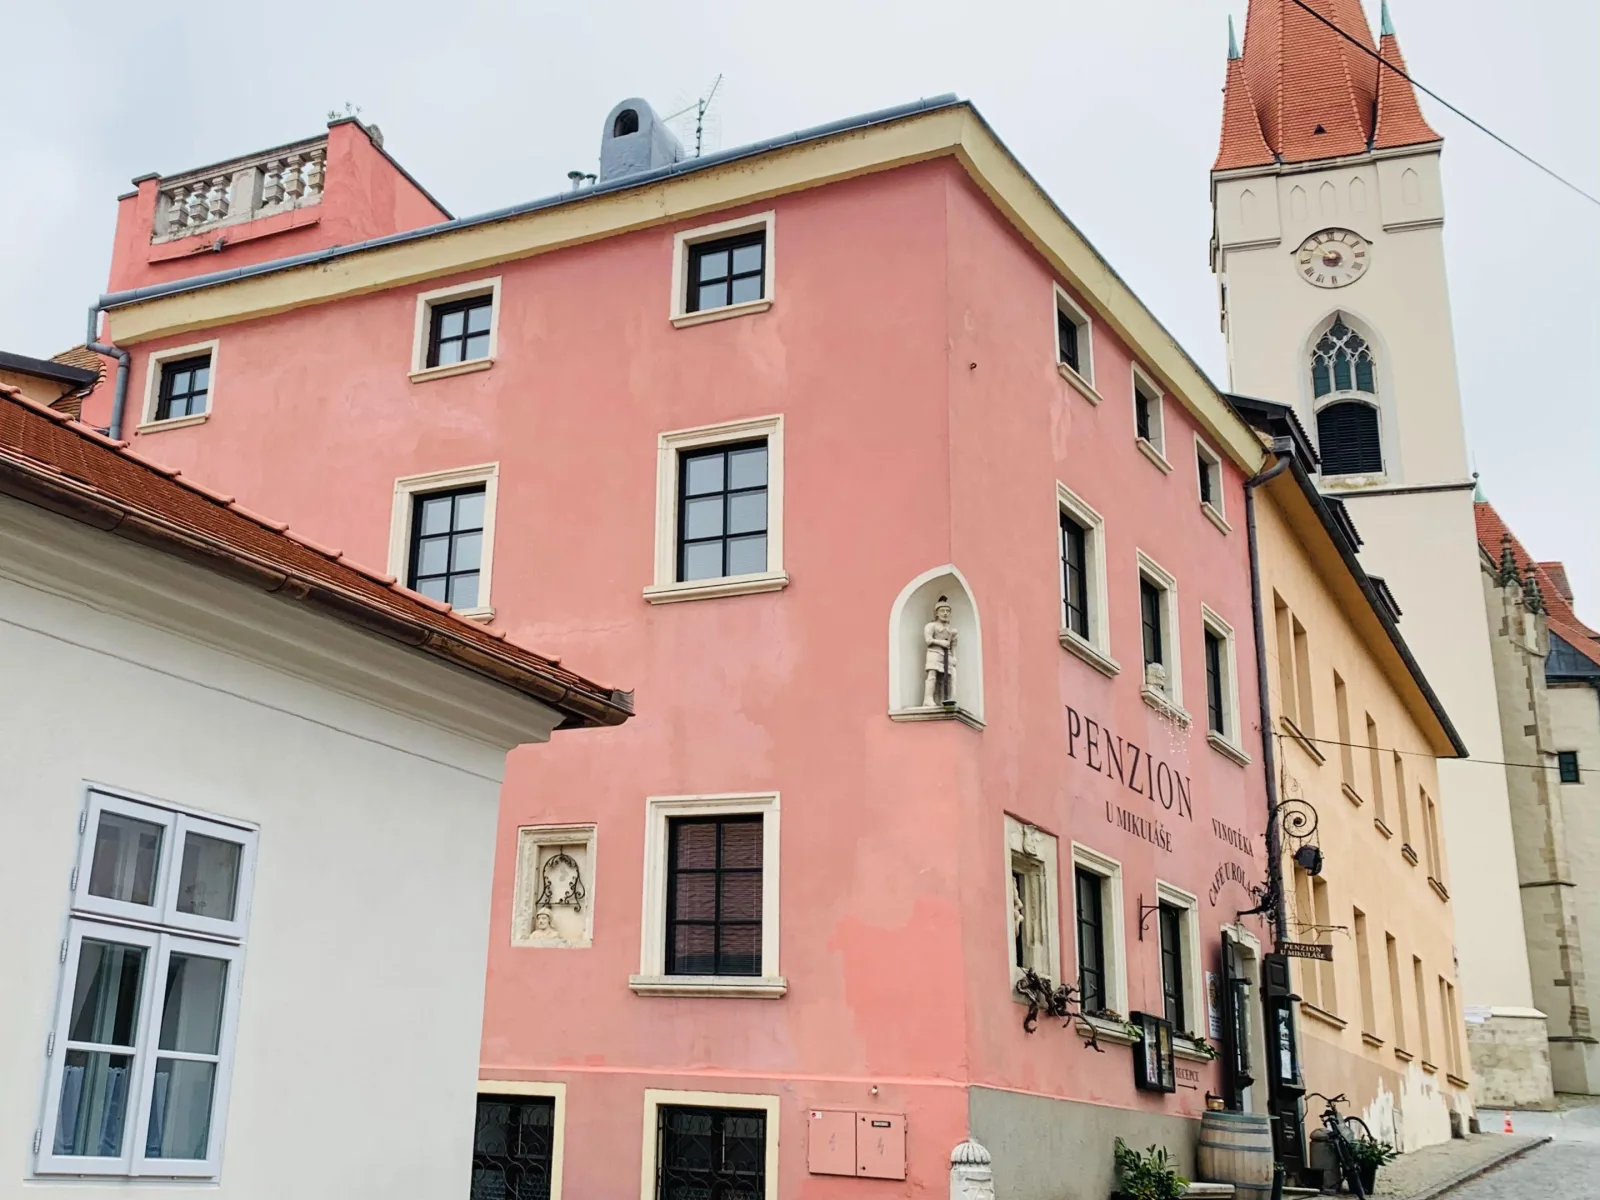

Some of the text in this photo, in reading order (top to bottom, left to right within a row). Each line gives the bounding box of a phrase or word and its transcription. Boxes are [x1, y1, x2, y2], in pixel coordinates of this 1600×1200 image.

[1065, 704, 1193, 823] PENZION
[1105, 800, 1173, 853] U MIKULÁŠE
[1212, 817, 1254, 857] VINOTÉKA
[1208, 861, 1226, 907] CAFÉ
[1224, 862, 1230, 880] U
[1284, 943, 1322, 952] PENZION
[1287, 950, 1326, 959] MIKULÁŠE
